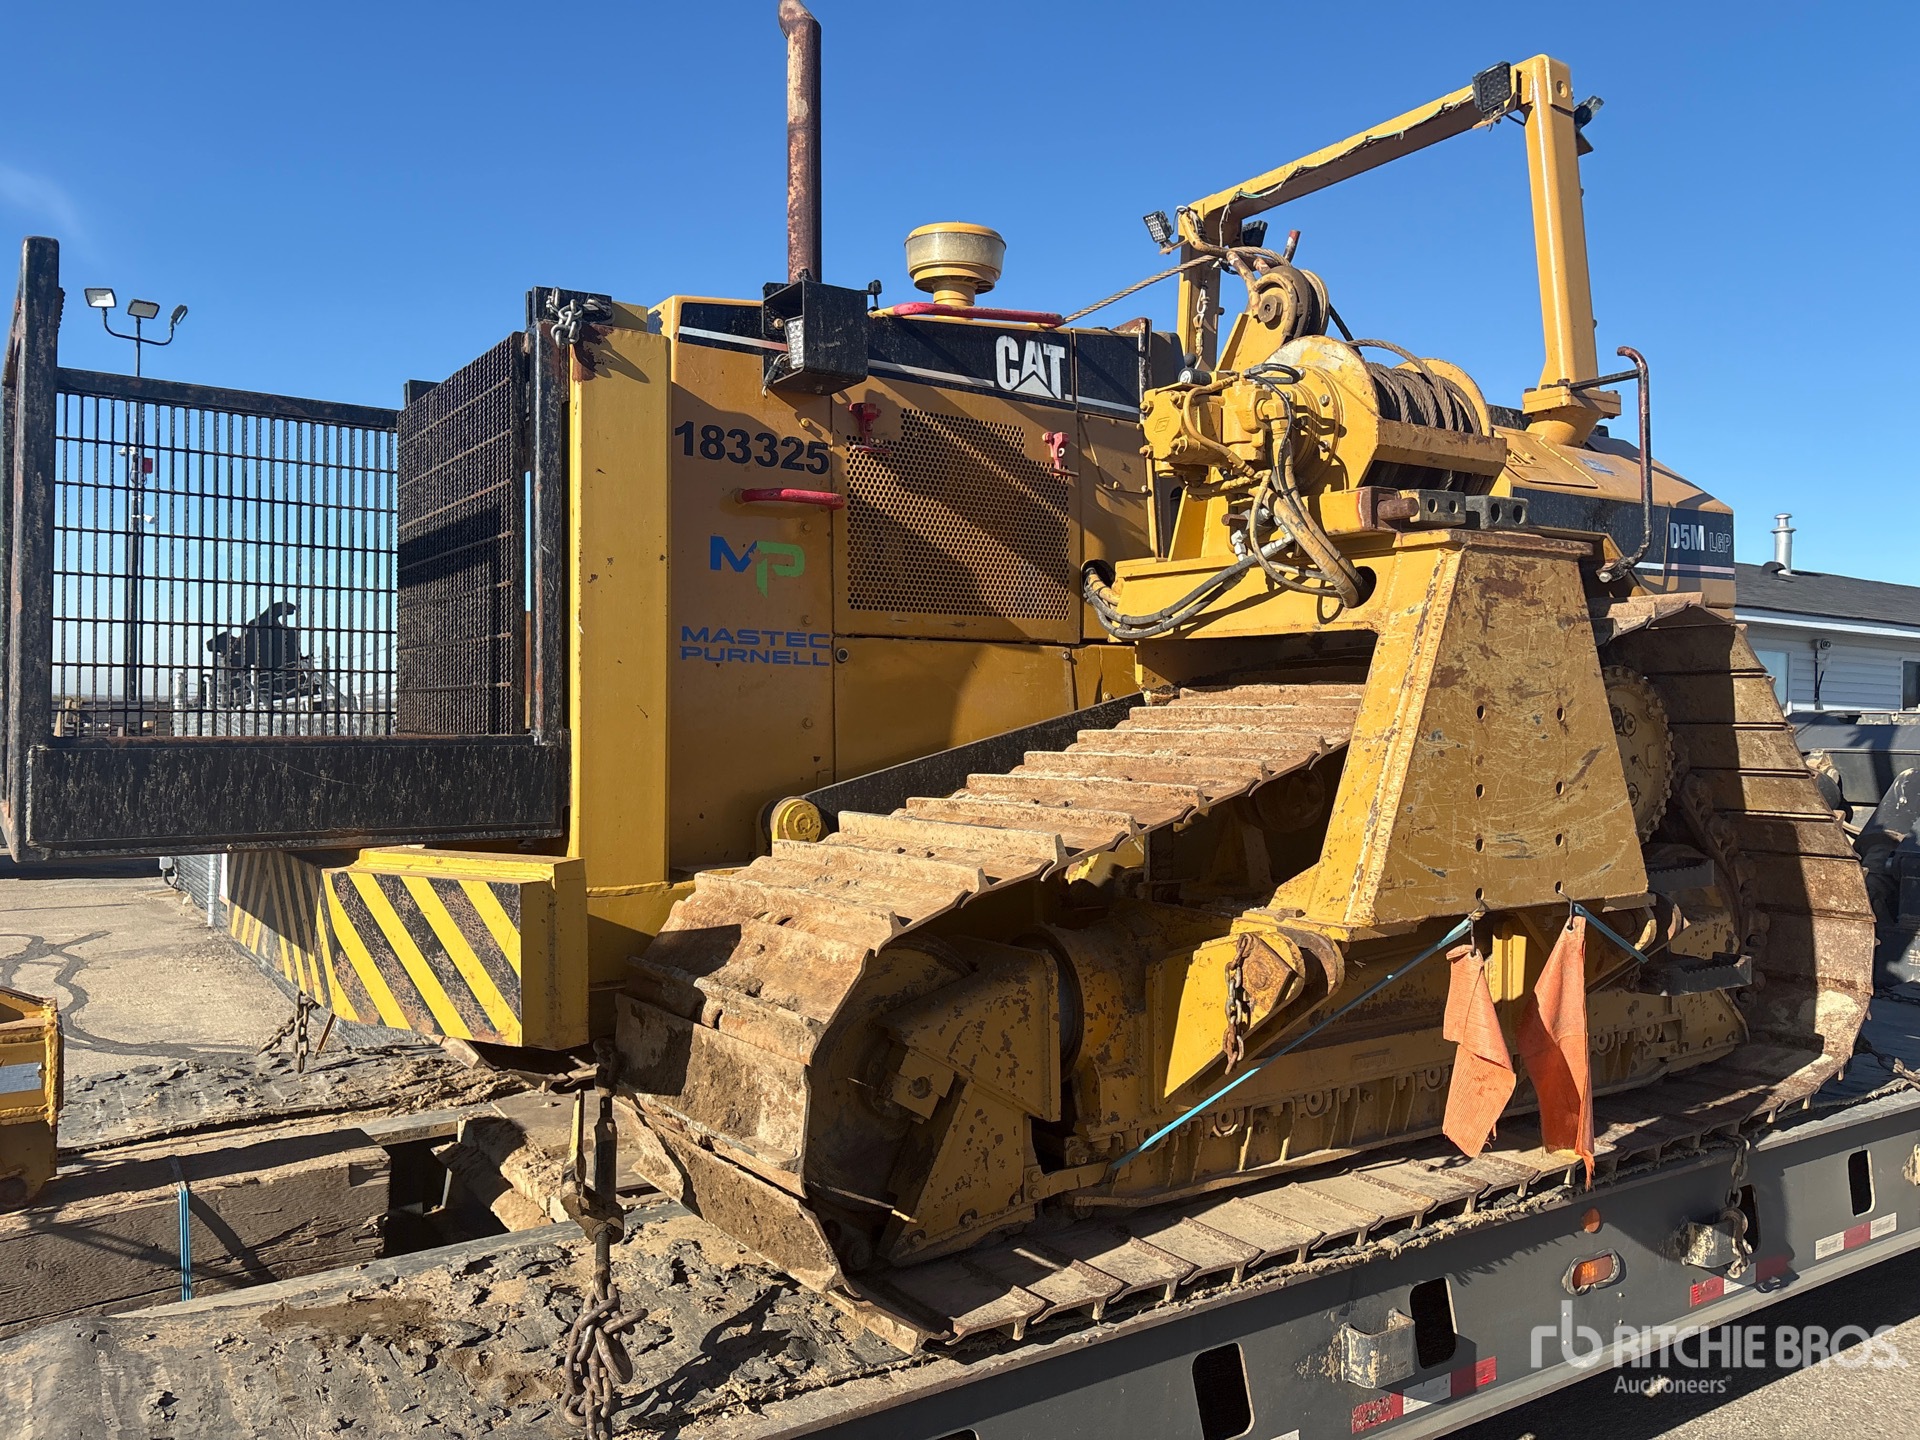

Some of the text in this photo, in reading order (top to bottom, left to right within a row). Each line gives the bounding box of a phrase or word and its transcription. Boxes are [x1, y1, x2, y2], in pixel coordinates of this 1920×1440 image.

[995, 335, 1066, 400] CAT
[674, 420, 830, 475] 183325
[1669, 522, 1732, 554] D5M LGP
[709, 534, 806, 599] MP
[681, 625, 830, 649] MASTEC
[681, 646, 830, 667] PURNELL
